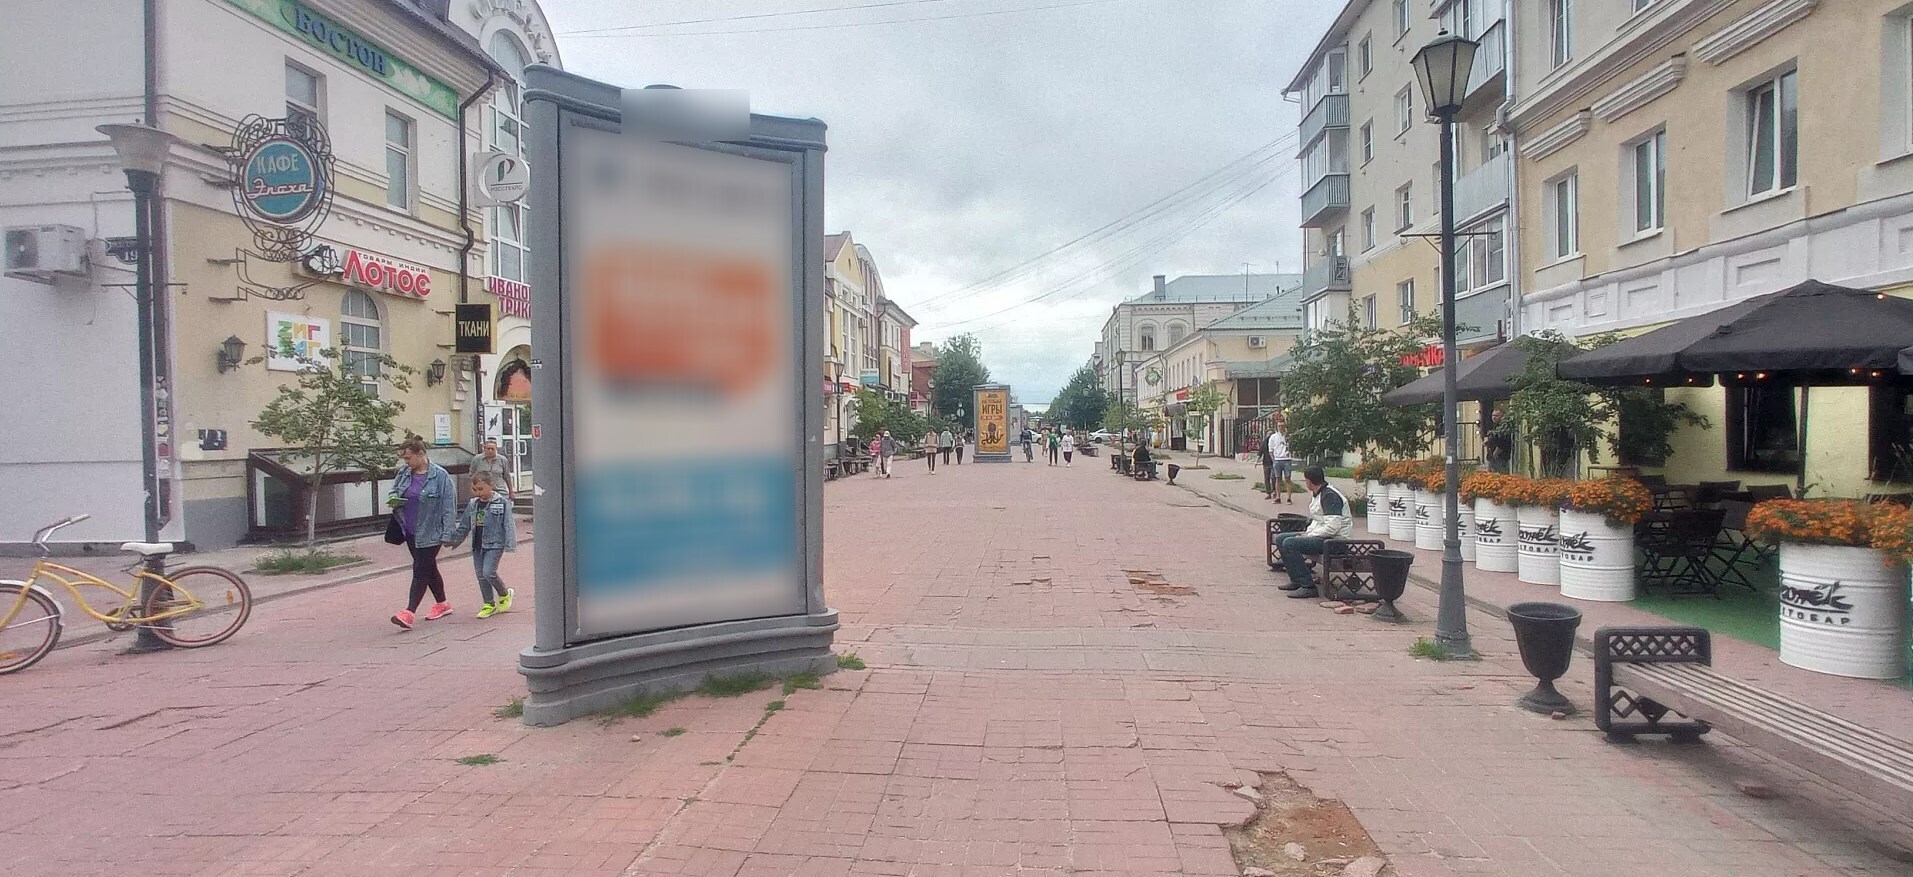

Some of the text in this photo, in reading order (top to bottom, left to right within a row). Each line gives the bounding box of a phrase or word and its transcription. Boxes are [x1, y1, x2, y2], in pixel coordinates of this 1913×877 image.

[294, 6, 387, 76] БОСТОН
[257, 153, 300, 174] КАФЕ
[358, 252, 393, 266] ТОВАРЫ
[342, 249, 431, 297] ЛОТОС
[489, 276, 531, 303] ИВАНО
[499, 296, 531, 319] ТРИК
[458, 320, 490, 338] ТКАНИ
[982, 403, 1003, 415] ИГРЫ
